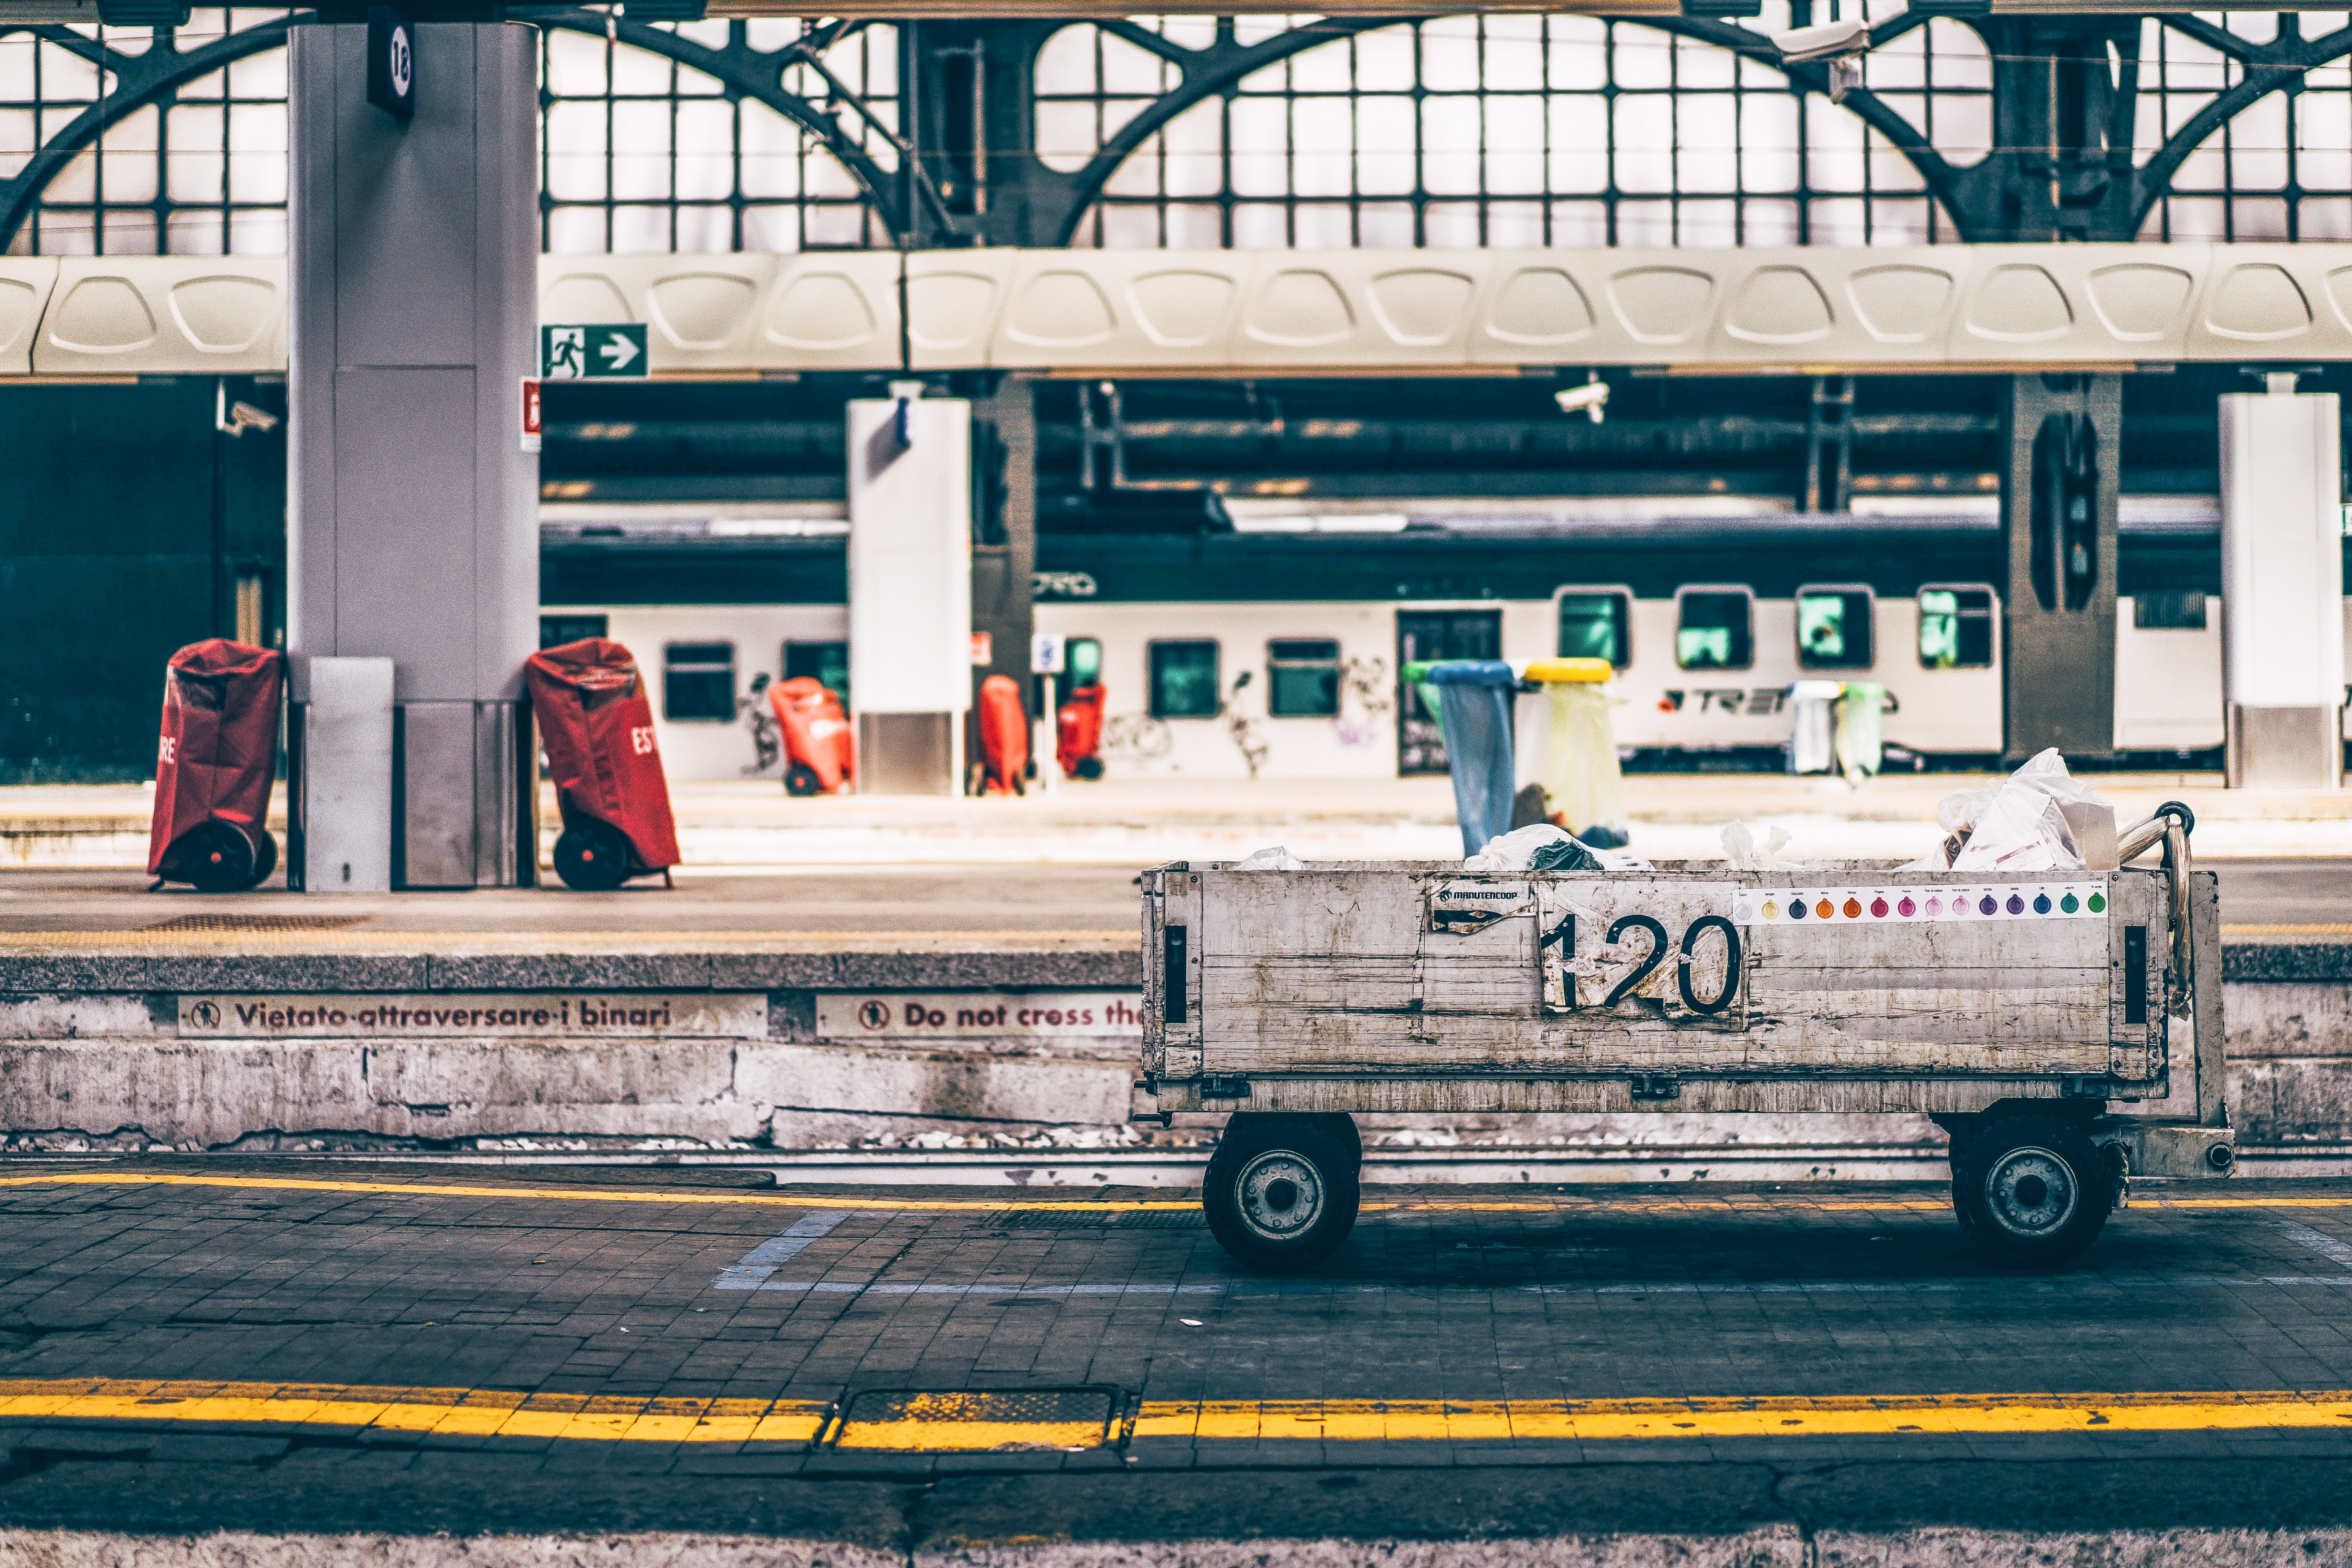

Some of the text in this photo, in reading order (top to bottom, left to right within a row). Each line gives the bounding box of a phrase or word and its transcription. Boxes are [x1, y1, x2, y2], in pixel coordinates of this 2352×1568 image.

[1541, 913, 1741, 1014] 120
[236, 1000, 671, 1028] Vietato attraversare i binari
[904, 1002, 947, 1027] Do
[957, 1005, 1007, 1026] not
[1018, 1009, 1093, 1026] cross
